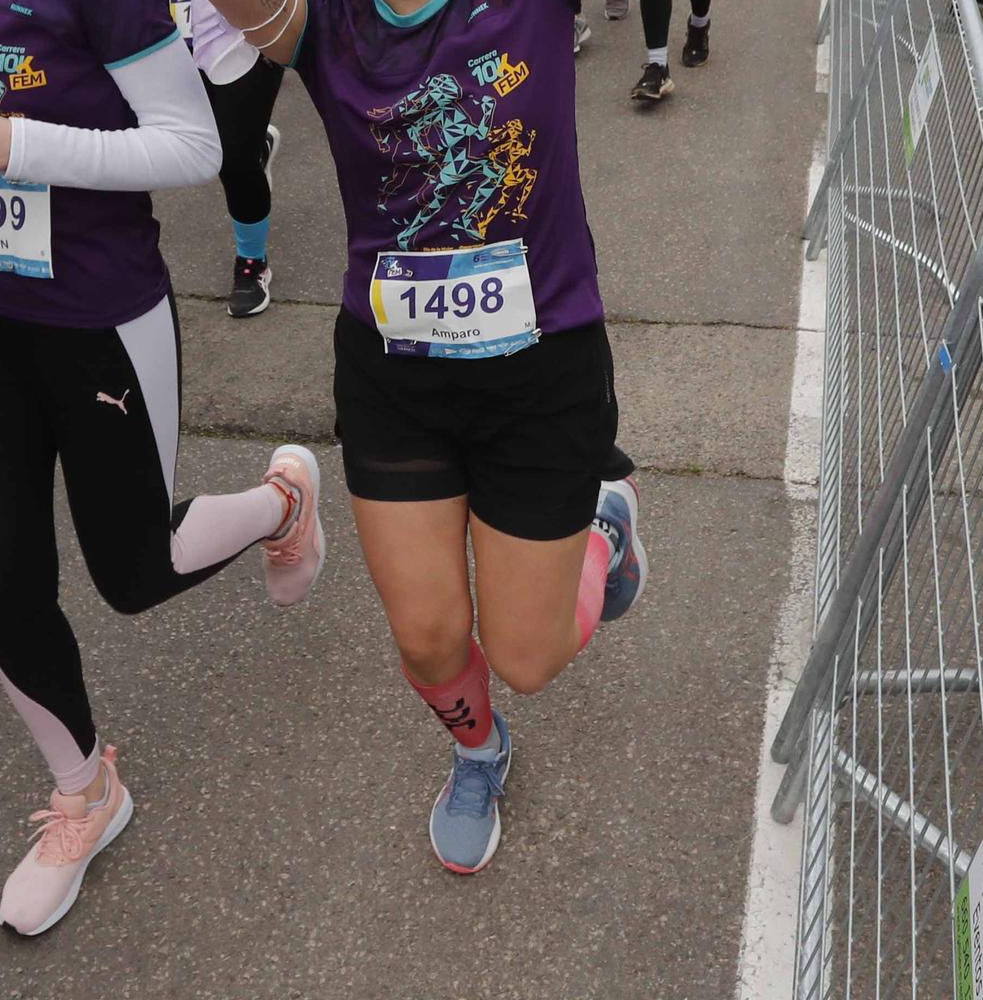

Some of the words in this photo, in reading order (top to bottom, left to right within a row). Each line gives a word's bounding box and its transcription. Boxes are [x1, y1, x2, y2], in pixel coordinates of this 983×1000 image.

[467, 49, 498, 68] Carrera
[471, 52, 516, 87] 10K
[12, 72, 43, 88] FEM
[497, 66, 527, 95] FEM
[400, 276, 504, 320] 1498
[431, 327, 481, 341] Amparo
